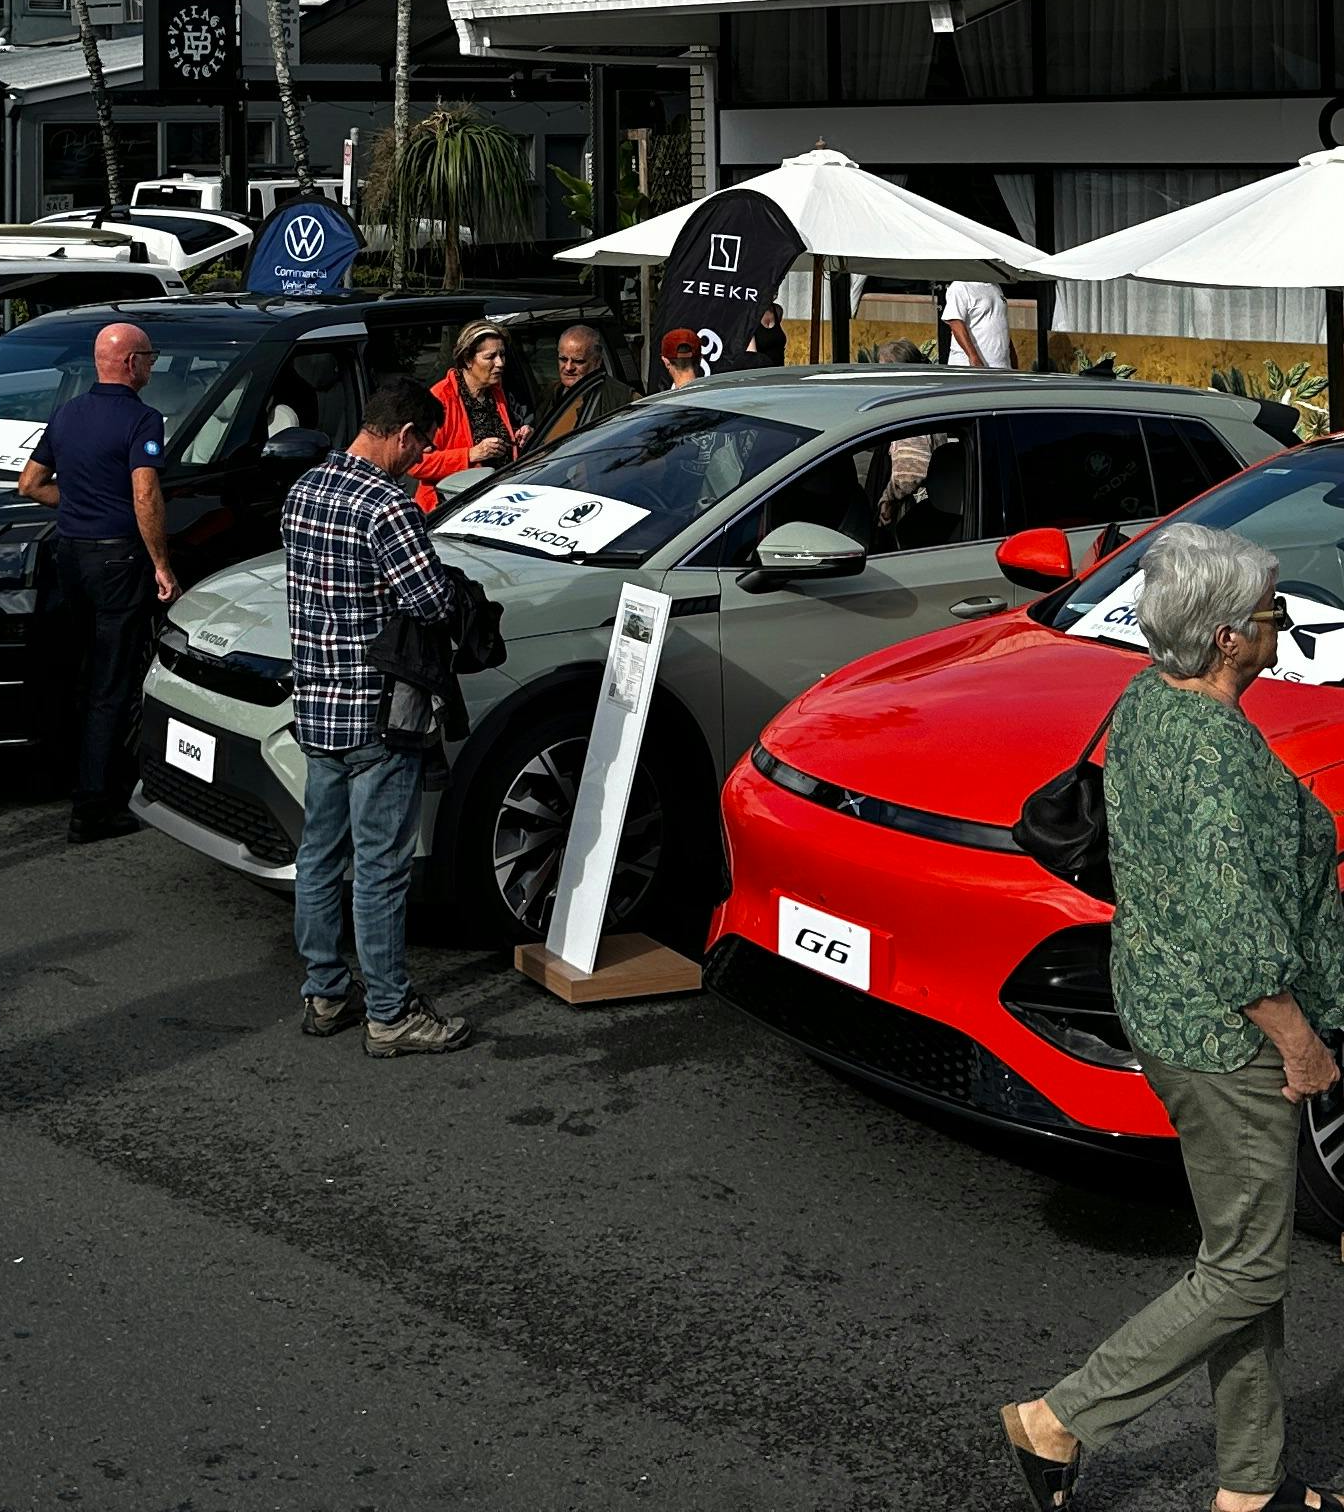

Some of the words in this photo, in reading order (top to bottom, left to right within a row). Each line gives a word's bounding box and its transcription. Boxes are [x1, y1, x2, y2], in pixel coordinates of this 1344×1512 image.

[168, 5, 226, 38] VILLAGE
[46, 201, 70, 212] SALE
[682, 280, 759, 302] ZEEKR
[460, 509, 522, 527] CRICKS
[517, 526, 581, 553] SKODA
[197, 630, 230, 648] SKODA
[178, 738, 202, 762] ELROQ
[795, 928, 852, 965] G6
